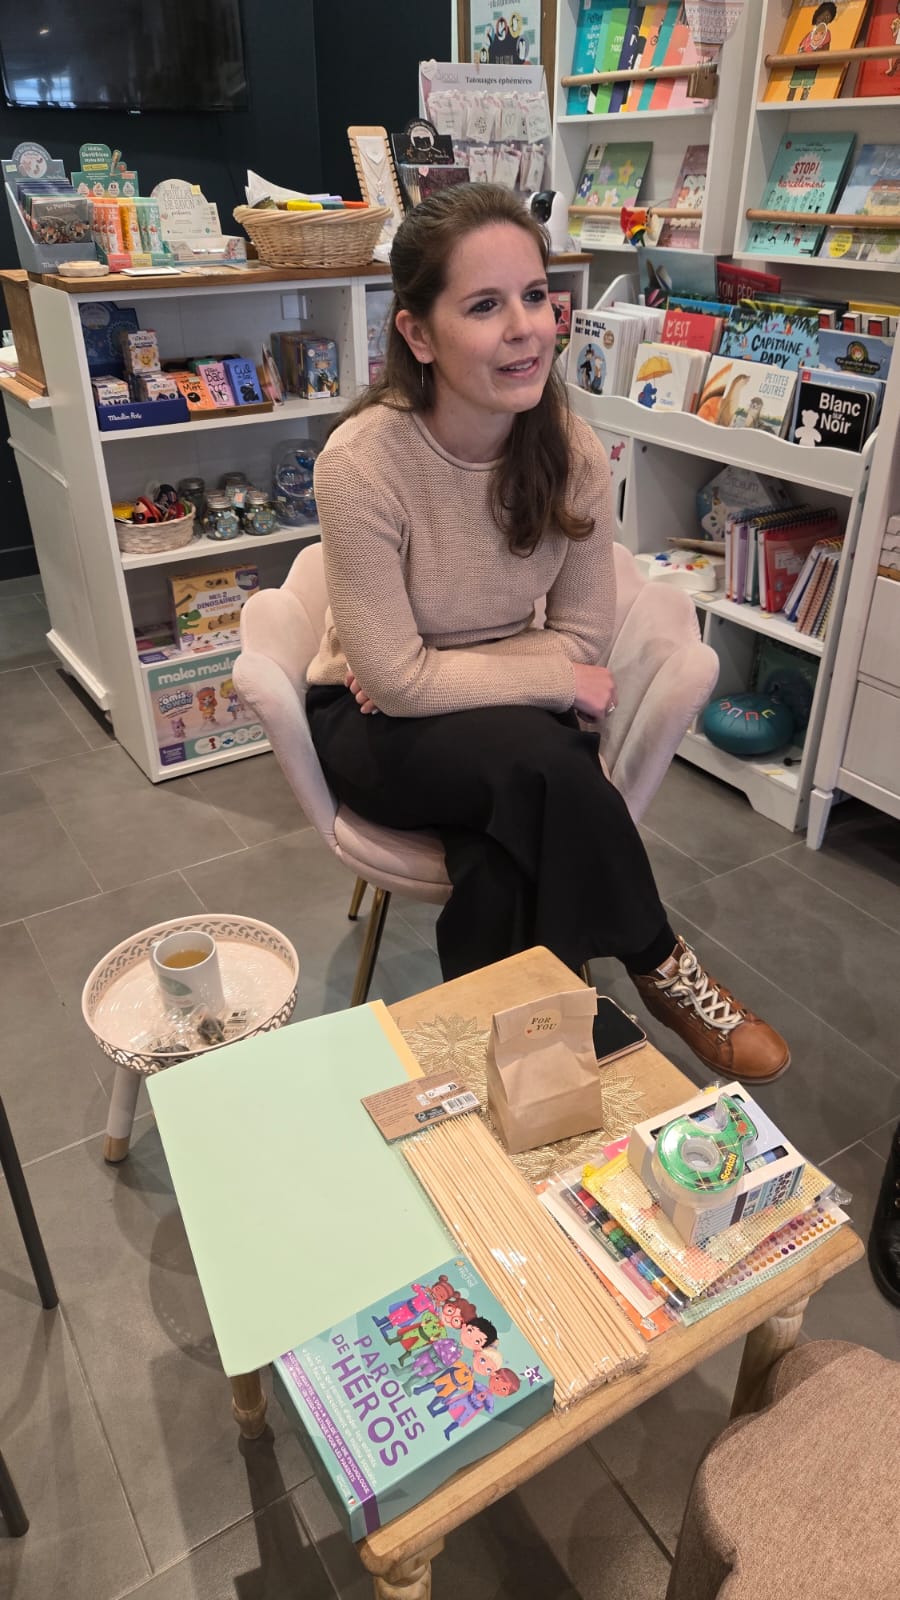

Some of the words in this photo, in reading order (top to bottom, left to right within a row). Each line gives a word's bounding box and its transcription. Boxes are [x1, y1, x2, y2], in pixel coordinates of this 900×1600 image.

[466, 76, 497, 85] Tatouages
[498, 76, 532, 85] éphémères
[765, 372, 789, 386] PETITES
[759, 382, 786, 397] LOUTRES
[819, 392, 861, 417] Blanc
[820, 415, 852, 435] Noir
[197, 595, 241, 609] DINOSAURES
[158, 667, 196, 685] mako
[719, 1152, 737, 1181] Scotch
[331, 1334, 350, 1355] DE
[524, 1368, 540, 1383] 6+
[353, 1335, 425, 1440] PAROLES
[331, 1354, 409, 1467] HÉROS
